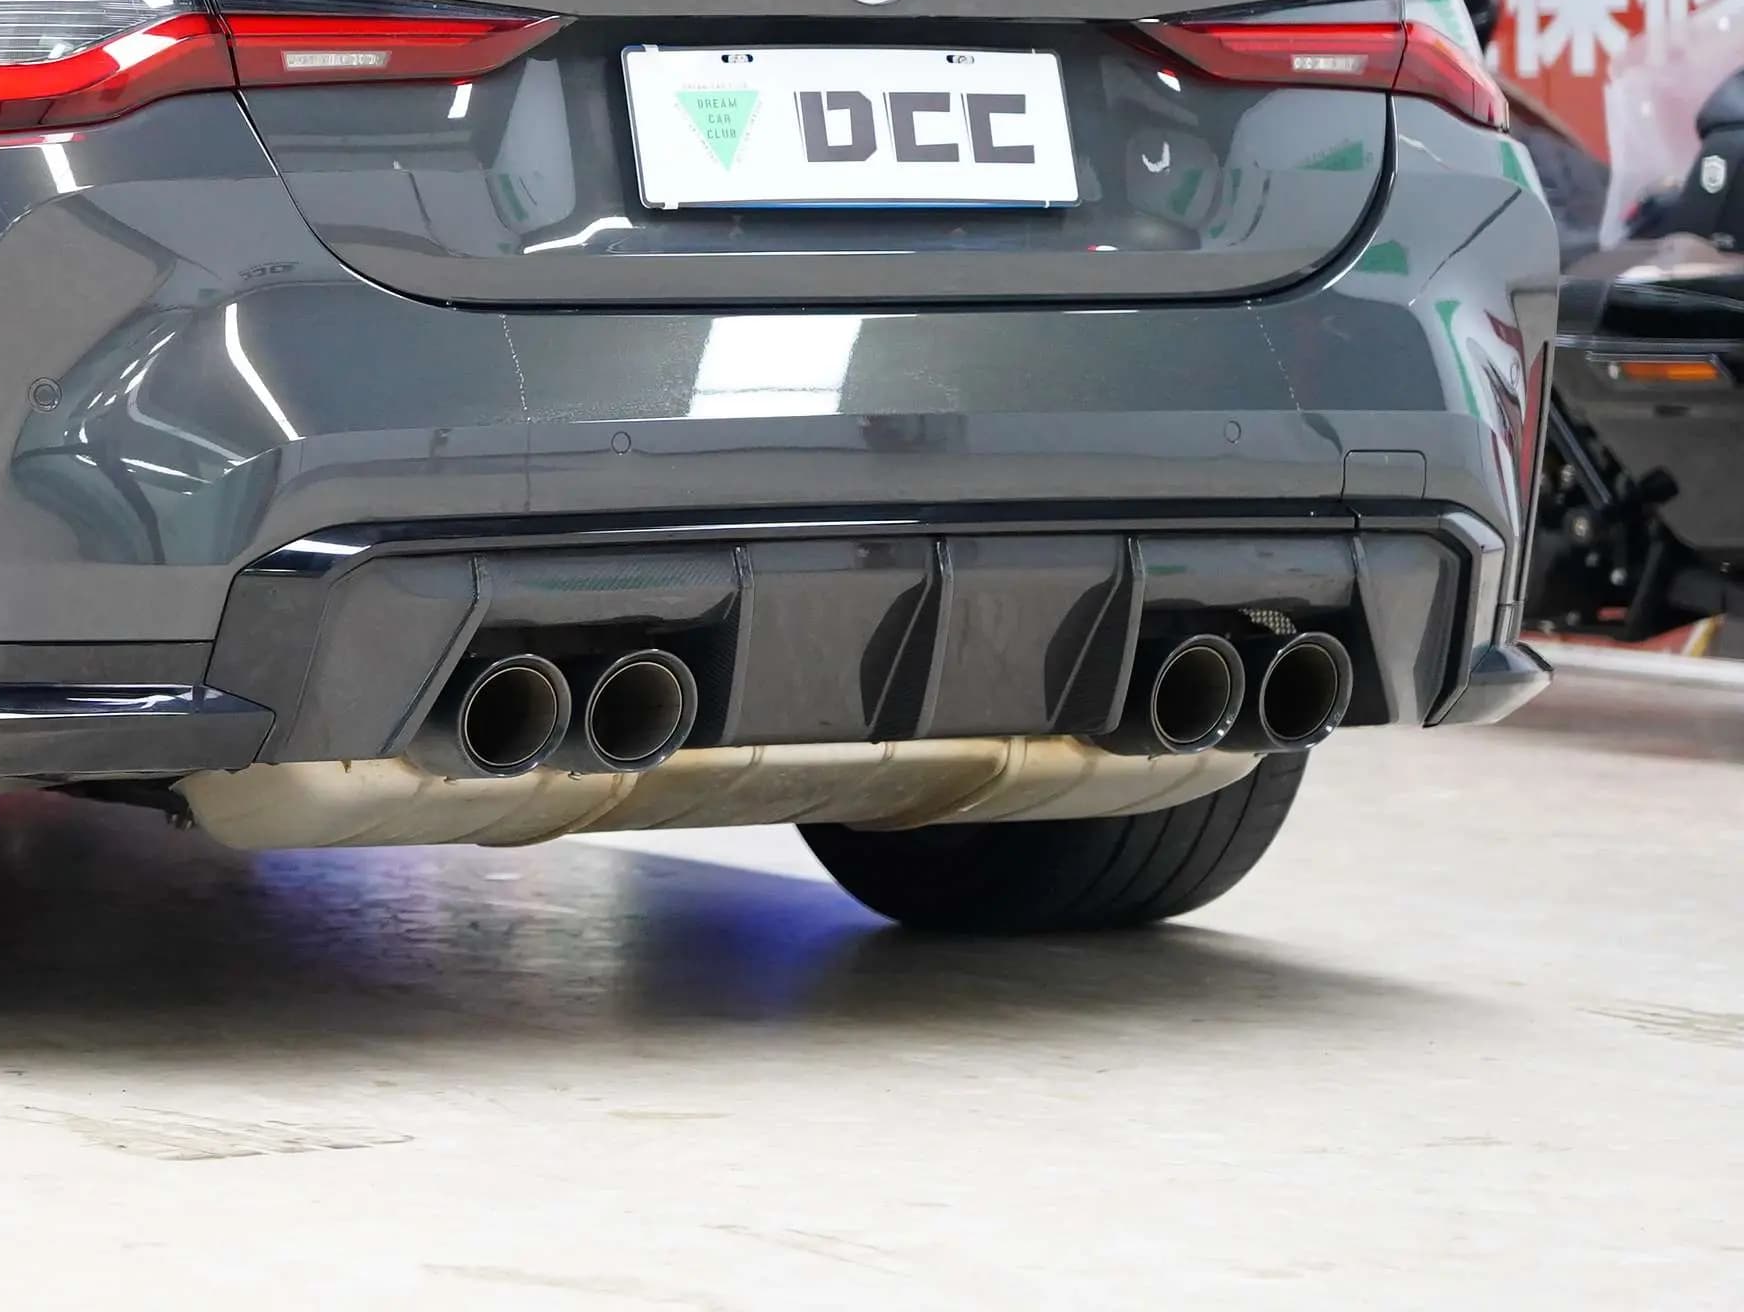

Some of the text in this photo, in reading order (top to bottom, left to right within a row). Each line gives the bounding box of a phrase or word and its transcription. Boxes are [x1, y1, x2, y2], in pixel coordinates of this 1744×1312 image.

[697, 97, 737, 109] DREAM
[708, 113, 732, 124] CAR
[793, 90, 1035, 164] DCC
[707, 128, 737, 140] CLUB
